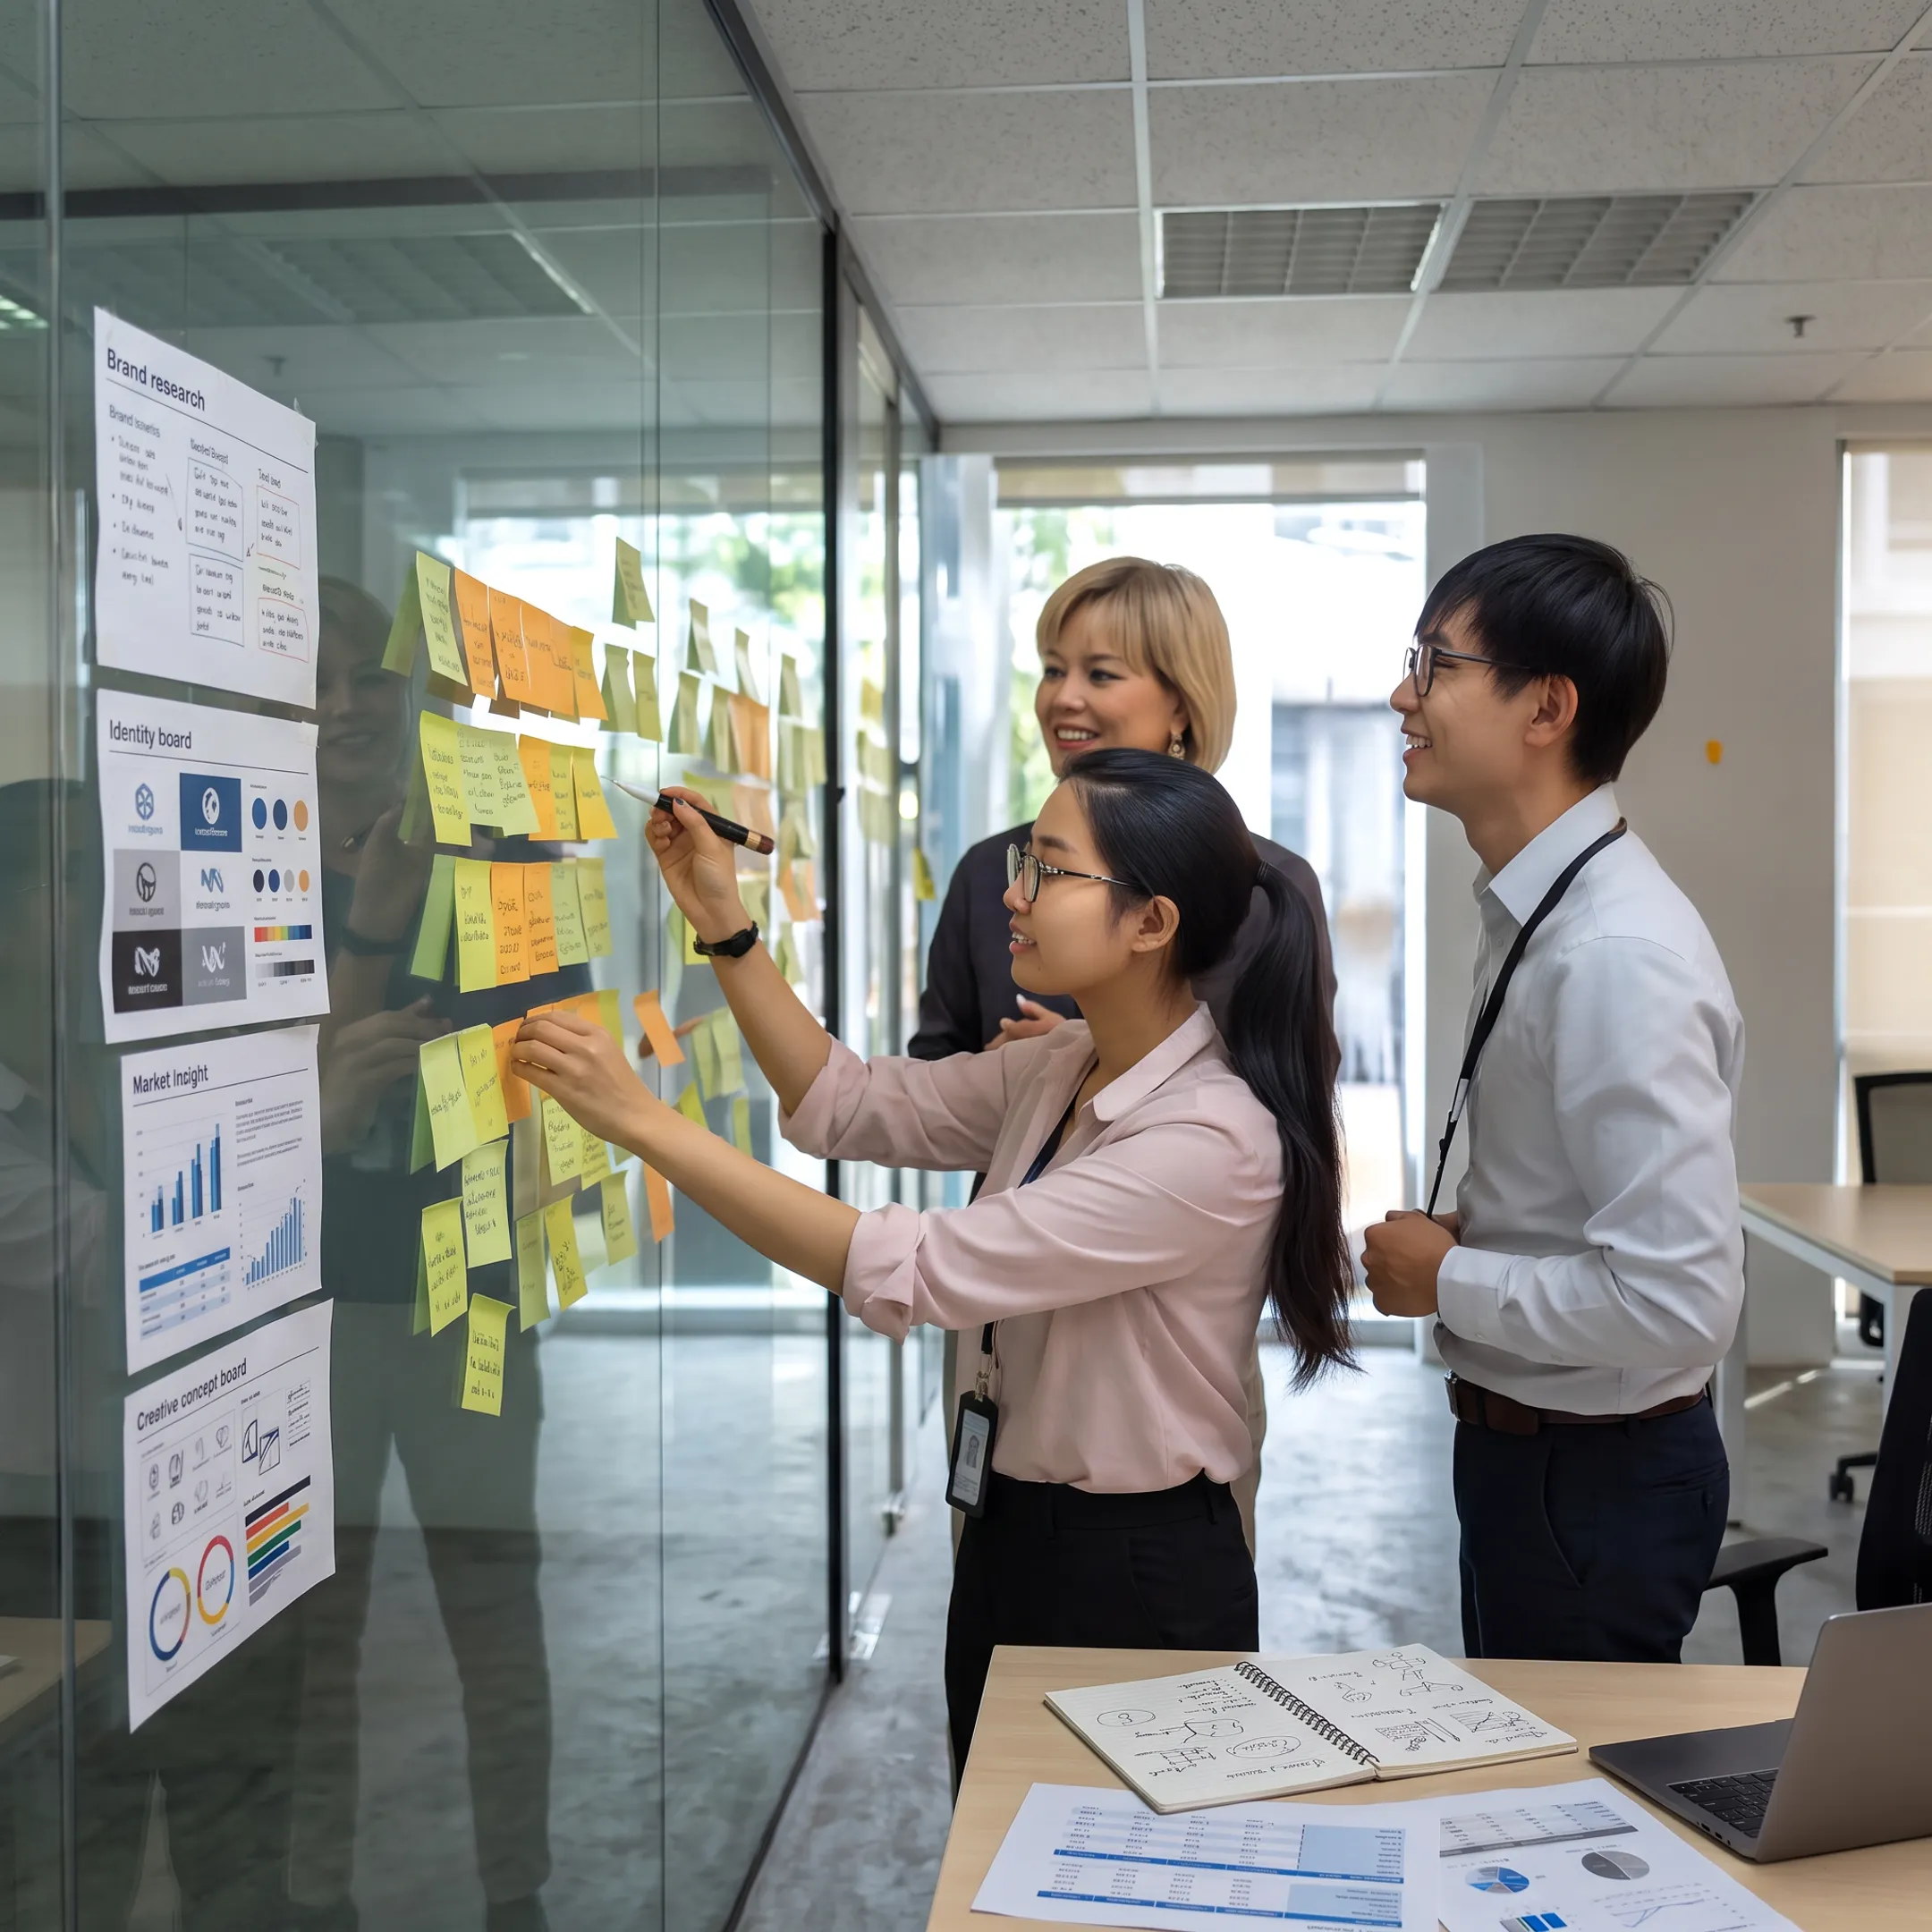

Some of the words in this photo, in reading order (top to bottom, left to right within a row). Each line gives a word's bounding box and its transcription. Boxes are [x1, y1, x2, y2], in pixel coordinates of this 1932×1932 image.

[106, 348, 148, 385] Brand
[150, 374, 206, 411] research
[109, 719, 157, 750] Identity
[158, 727, 192, 750] board
[132, 1072, 171, 1095] Market
[137, 1398, 179, 1431] Creative
[181, 1373, 218, 1408] concept
[220, 1357, 247, 1387] board
